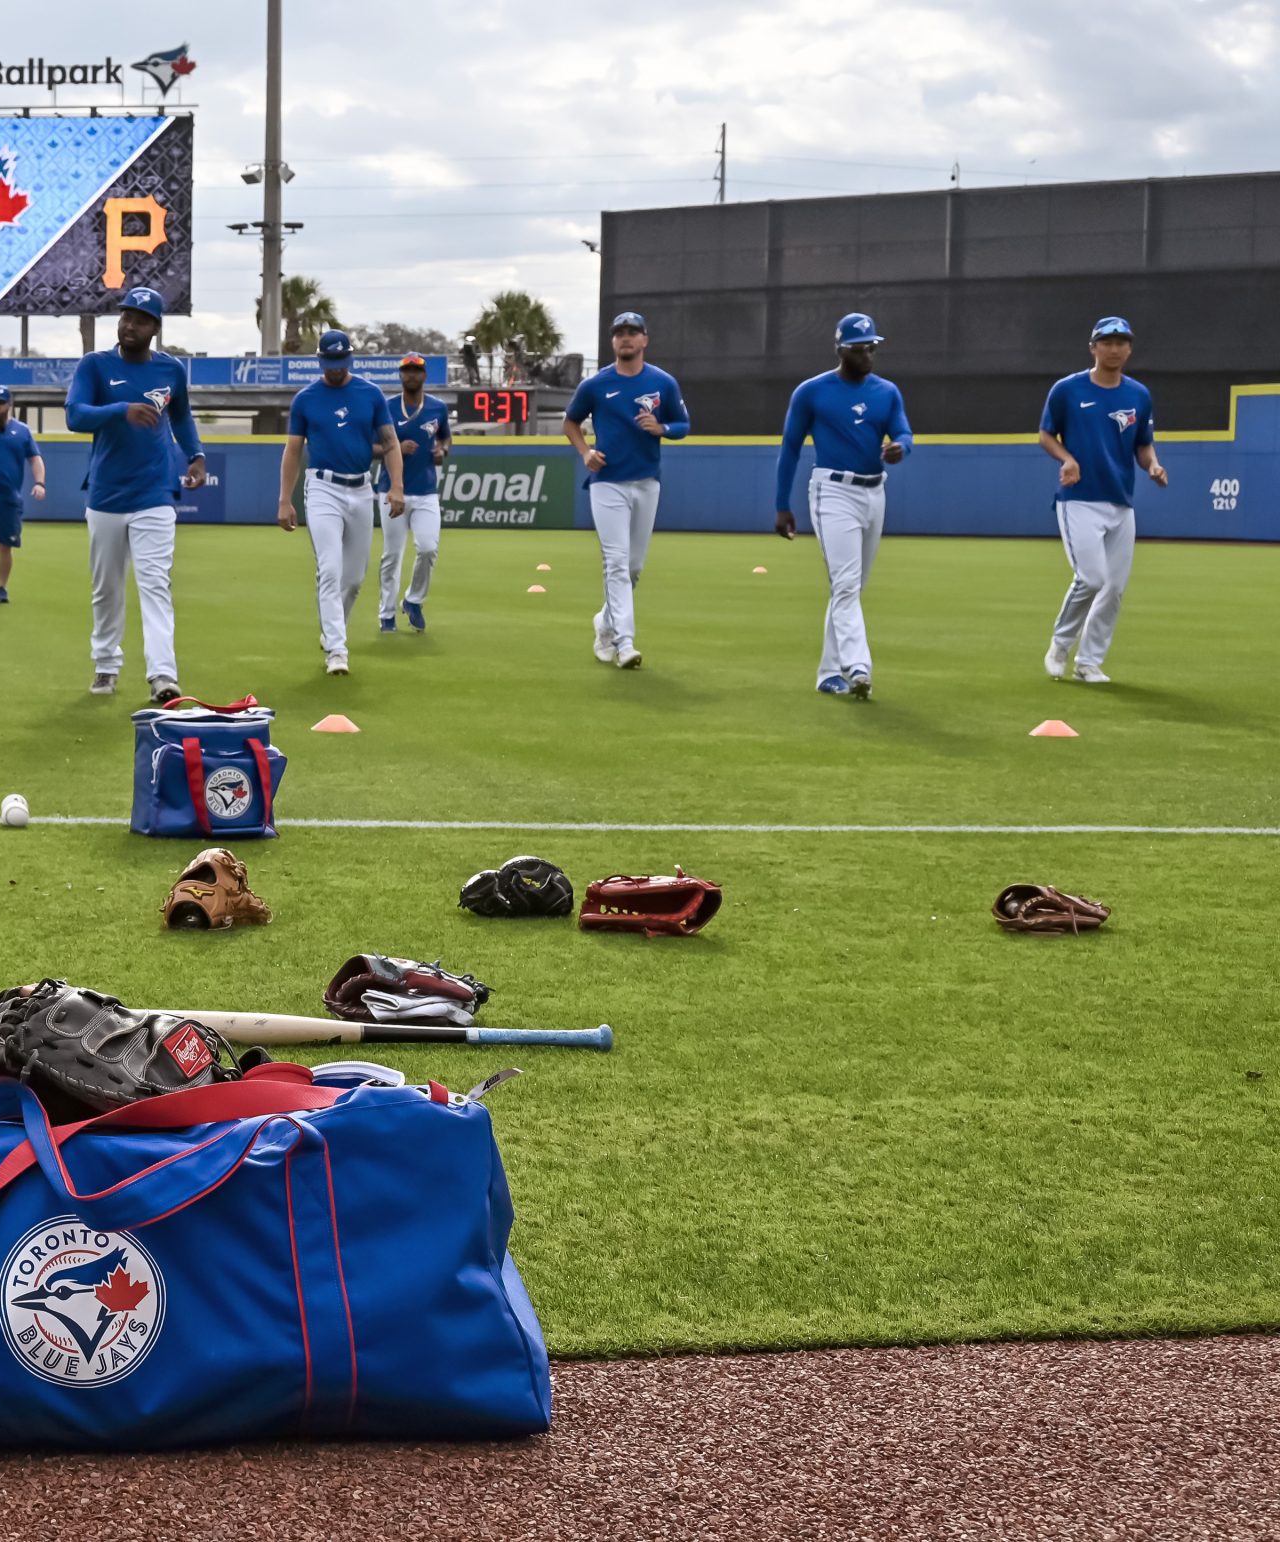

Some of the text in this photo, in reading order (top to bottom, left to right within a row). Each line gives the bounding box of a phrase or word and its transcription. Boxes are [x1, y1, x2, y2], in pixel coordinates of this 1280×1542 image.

[102, 194, 168, 289] P
[288, 361, 320, 370] DOWN
[474, 392, 528, 422] 9:37
[1209, 478, 1240, 497] 400
[471, 507, 536, 524] Rental
[210, 771, 241, 785] TORONTO
[208, 796, 246, 815] BLUE JAYS
[13, 1229, 109, 1288] TORONTO
[17, 1318, 148, 1377] BLUE JAYS
